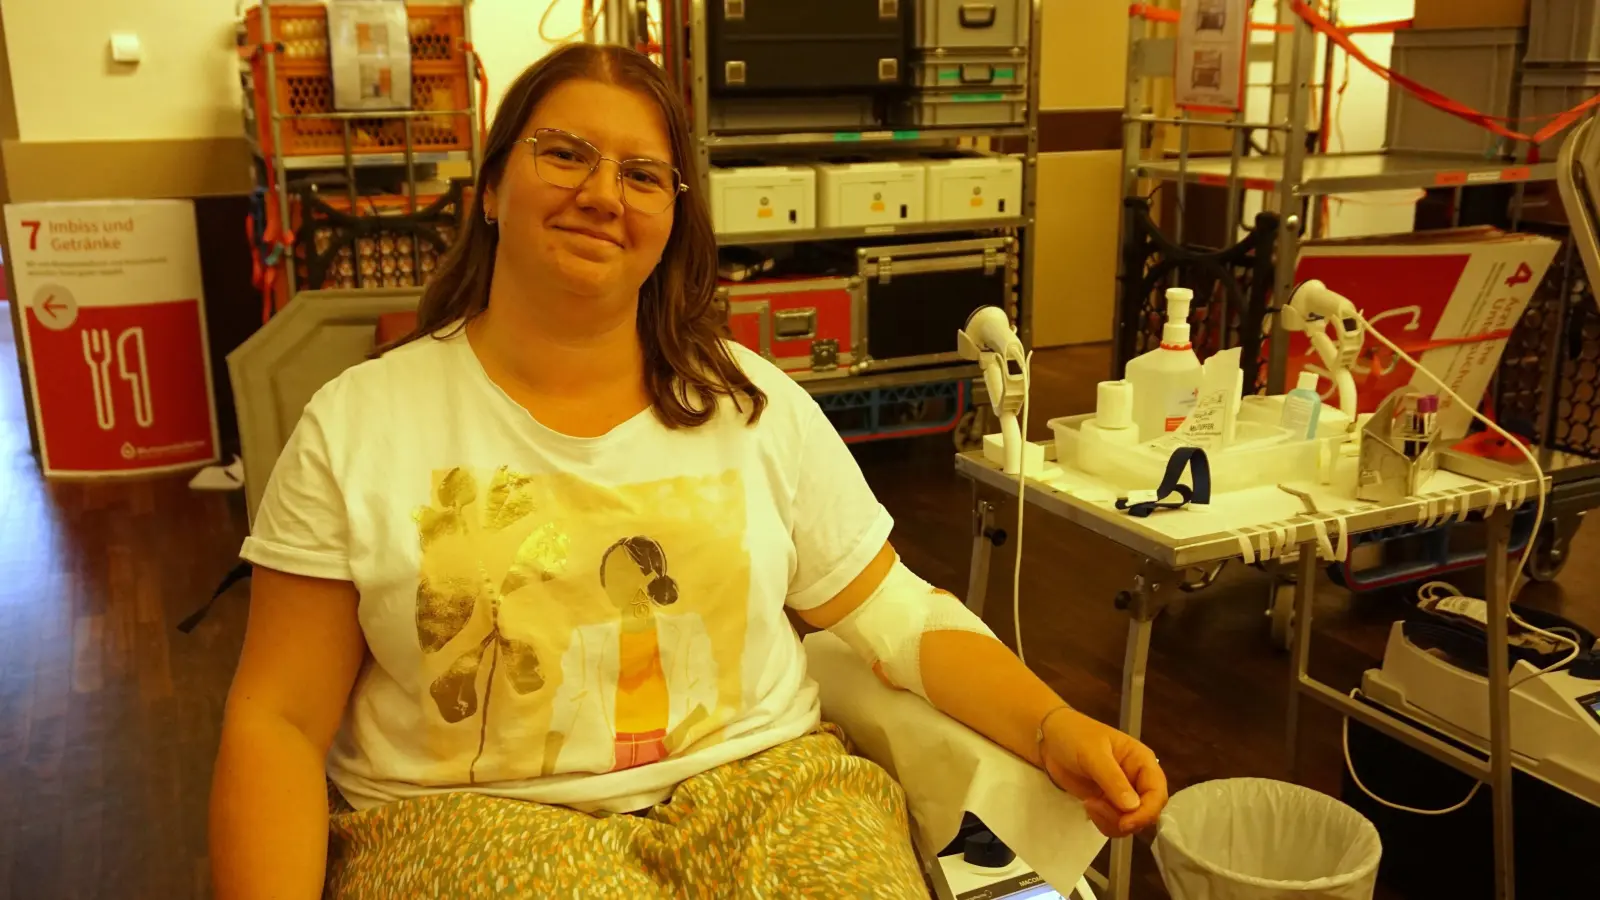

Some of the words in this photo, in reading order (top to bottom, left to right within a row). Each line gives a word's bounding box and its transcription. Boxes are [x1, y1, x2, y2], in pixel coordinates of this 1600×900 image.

[21, 219, 41, 251] 7
[49, 219, 98, 235] Imbiss
[104, 217, 134, 233] und
[50, 237, 121, 251] Getränke
[1504, 261, 1532, 287] 4
